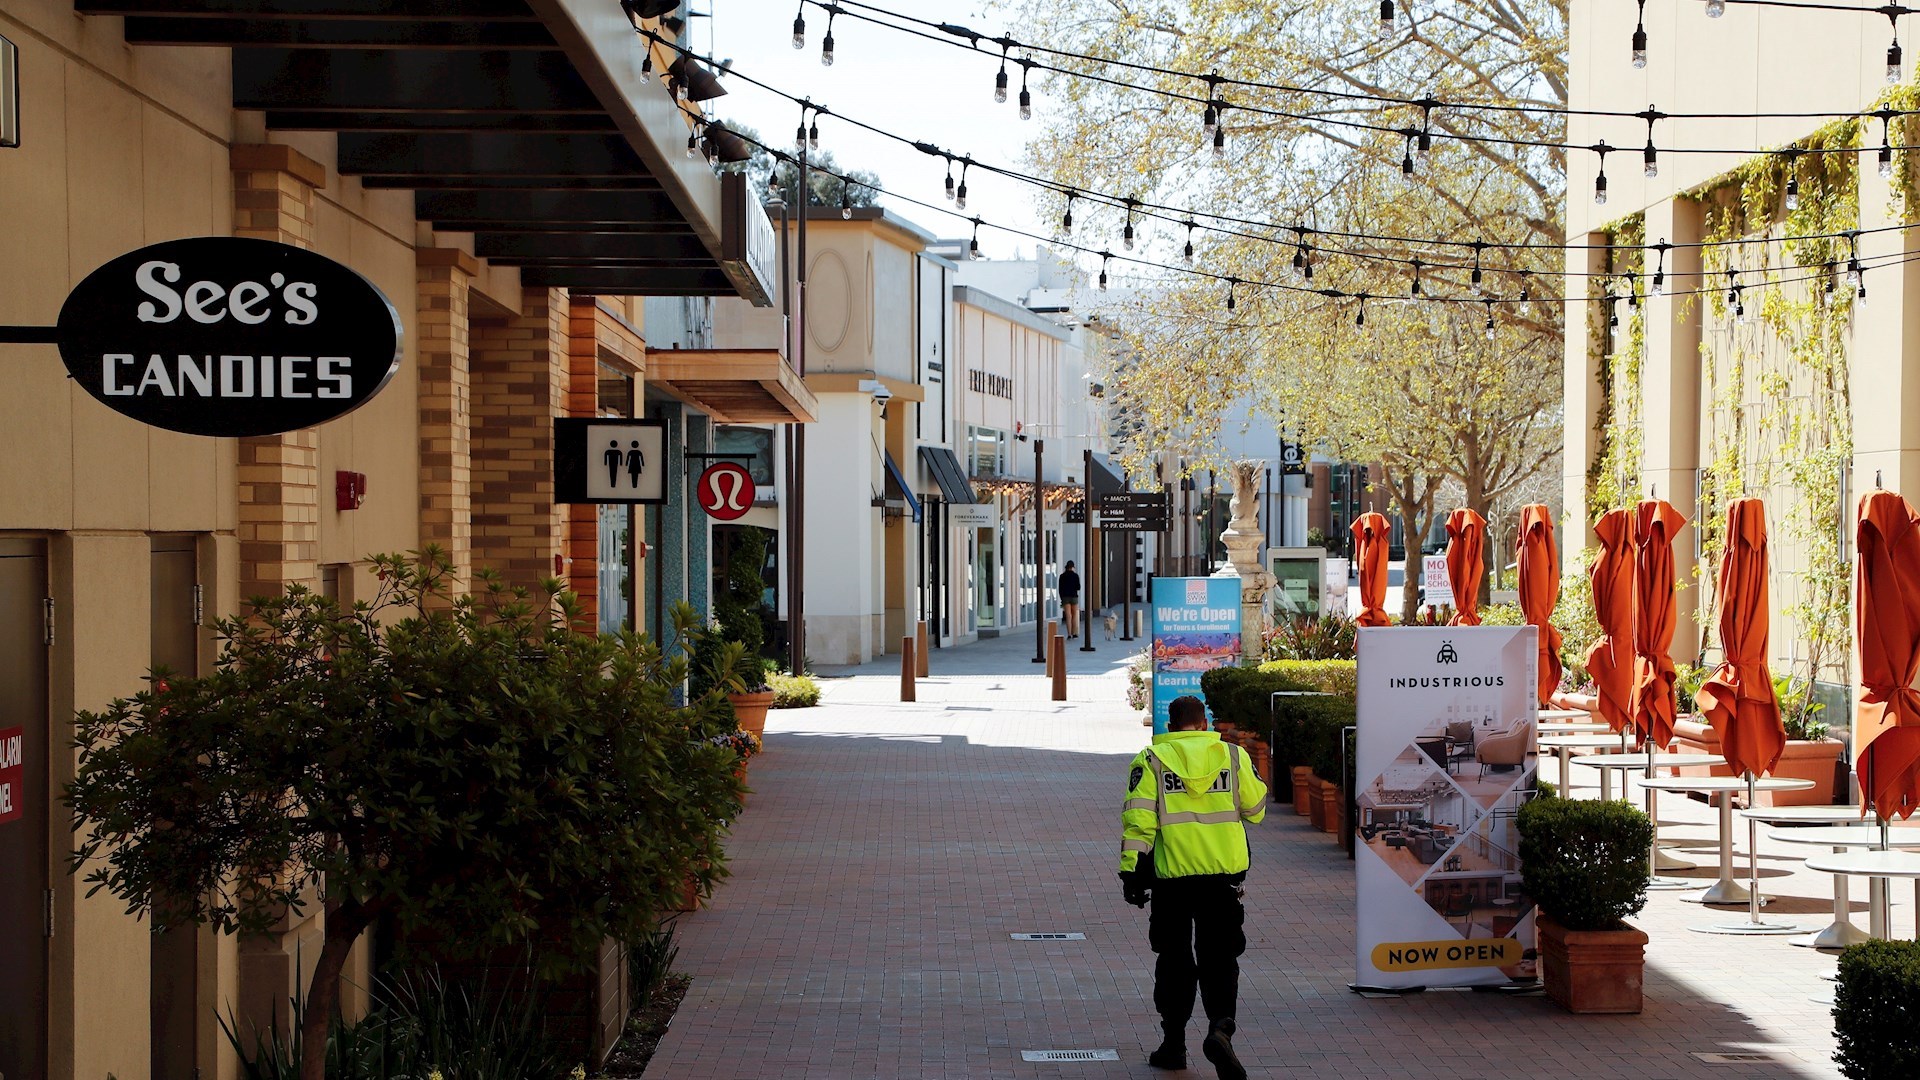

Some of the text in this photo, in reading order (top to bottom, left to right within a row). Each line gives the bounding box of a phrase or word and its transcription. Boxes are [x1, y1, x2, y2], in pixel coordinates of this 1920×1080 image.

[136, 261, 318, 325] See's
[103, 354, 352, 398] CANDIES
[1427, 560, 1445, 570] MO
[1158, 607, 1236, 622] We're Open
[1197, 623, 1230, 631] Enrollment
[1158, 675, 1188, 686] Learn
[1390, 676, 1504, 688] INDUSTRIOUS
[0, 783, 12, 814] NEL
[1389, 944, 1504, 965] NOW OPEN
